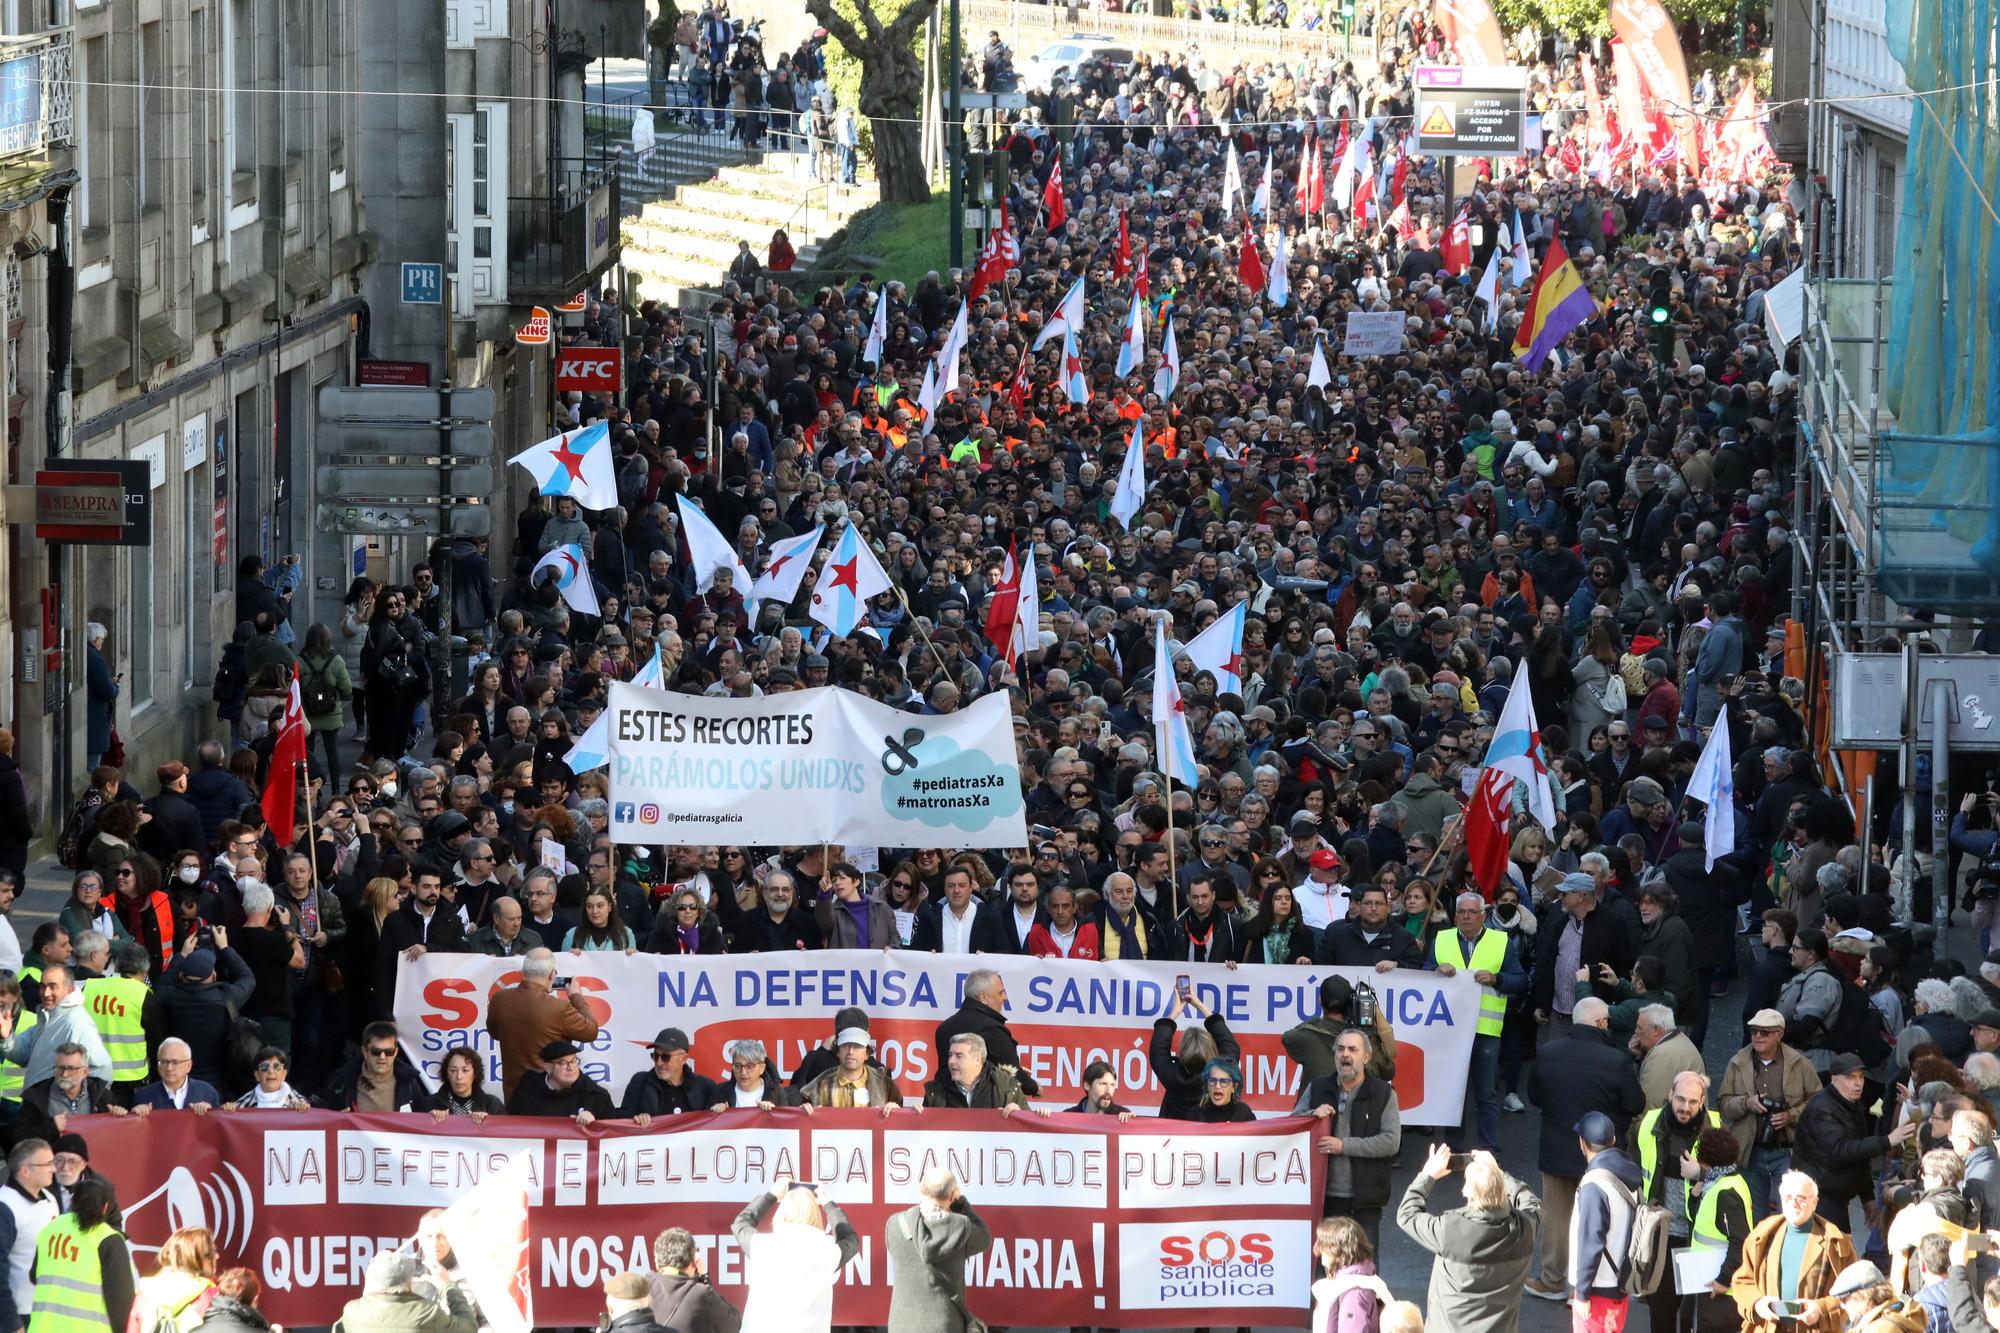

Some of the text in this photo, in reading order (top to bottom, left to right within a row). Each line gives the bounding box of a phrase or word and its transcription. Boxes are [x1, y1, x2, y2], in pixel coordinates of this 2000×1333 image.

[1458, 134, 1515, 142] MANIFESTACIÓN
[408, 269, 434, 288] PR
[517, 326, 548, 336] KING
[558, 361, 614, 378] KFC
[618, 709, 813, 745] ESTES RECORTES
[616, 750, 866, 793] PARÁMOLOS UNIDXS
[913, 775, 1005, 794] #pediatrasXa
[897, 794, 990, 809] #matronasXa
[667, 813, 743, 825] @pediatrasgalicia
[658, 971, 718, 1008] NA
[735, 970, 938, 1008] DEFENSA
[1267, 974, 1455, 1026] PÚICA
[267, 1146, 322, 1187] NA
[561, 1152, 583, 1189] E
[602, 1145, 797, 1187] MELLORA
[817, 1145, 869, 1185] DA
[888, 1146, 1103, 1190] SANIDADE
[1124, 1138, 1308, 1190] PÚBLICA
[1160, 1230, 1274, 1267] SOS
[1160, 1259, 1275, 1280] sanidade
[1160, 1279, 1274, 1302] pública
